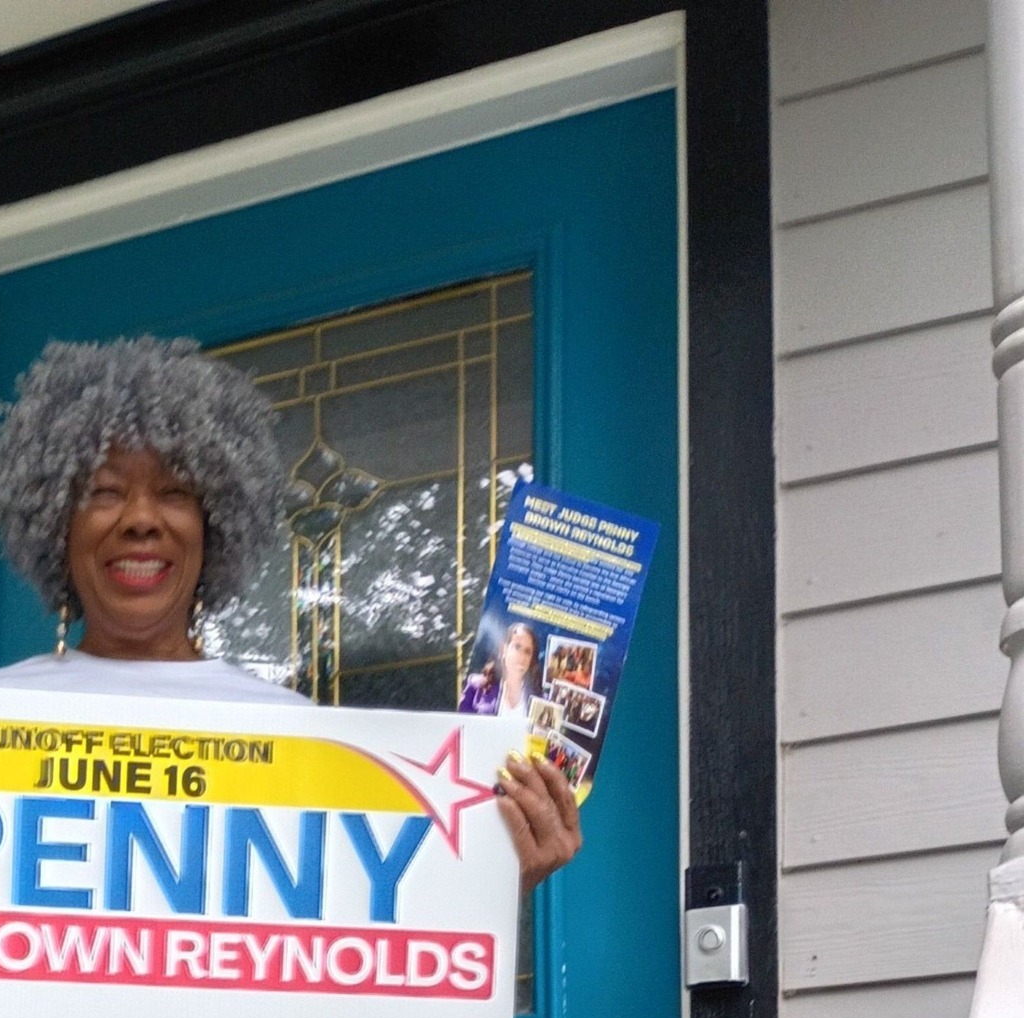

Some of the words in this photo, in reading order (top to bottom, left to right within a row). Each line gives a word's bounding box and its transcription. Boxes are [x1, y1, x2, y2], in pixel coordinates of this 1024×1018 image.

[524, 510, 570, 536] BROWN
[571, 526, 634, 557] REYNOLDS
[598, 520, 639, 543] PENNY
[109, 731, 274, 764] ELECTION
[33, 756, 152, 794] JUNE
[163, 765, 207, 797] 16
[166, 929, 492, 992] REYNOLDS
